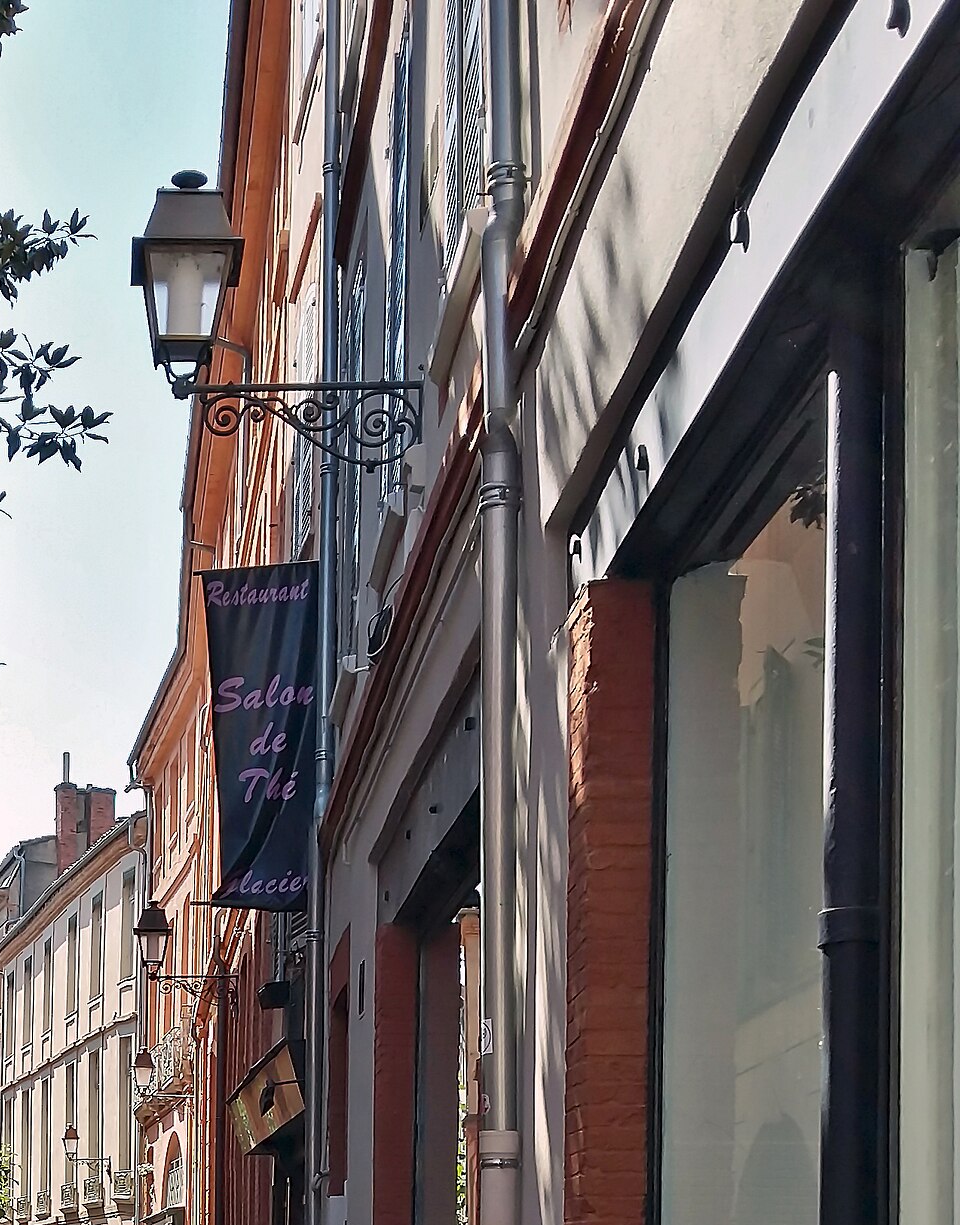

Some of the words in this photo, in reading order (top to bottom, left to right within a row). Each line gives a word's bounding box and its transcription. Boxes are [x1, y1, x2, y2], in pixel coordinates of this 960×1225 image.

[206, 577, 309, 608] Restaurant
[213, 673, 314, 714] Salon
[249, 721, 288, 757] de
[238, 766, 298, 804] Thé
